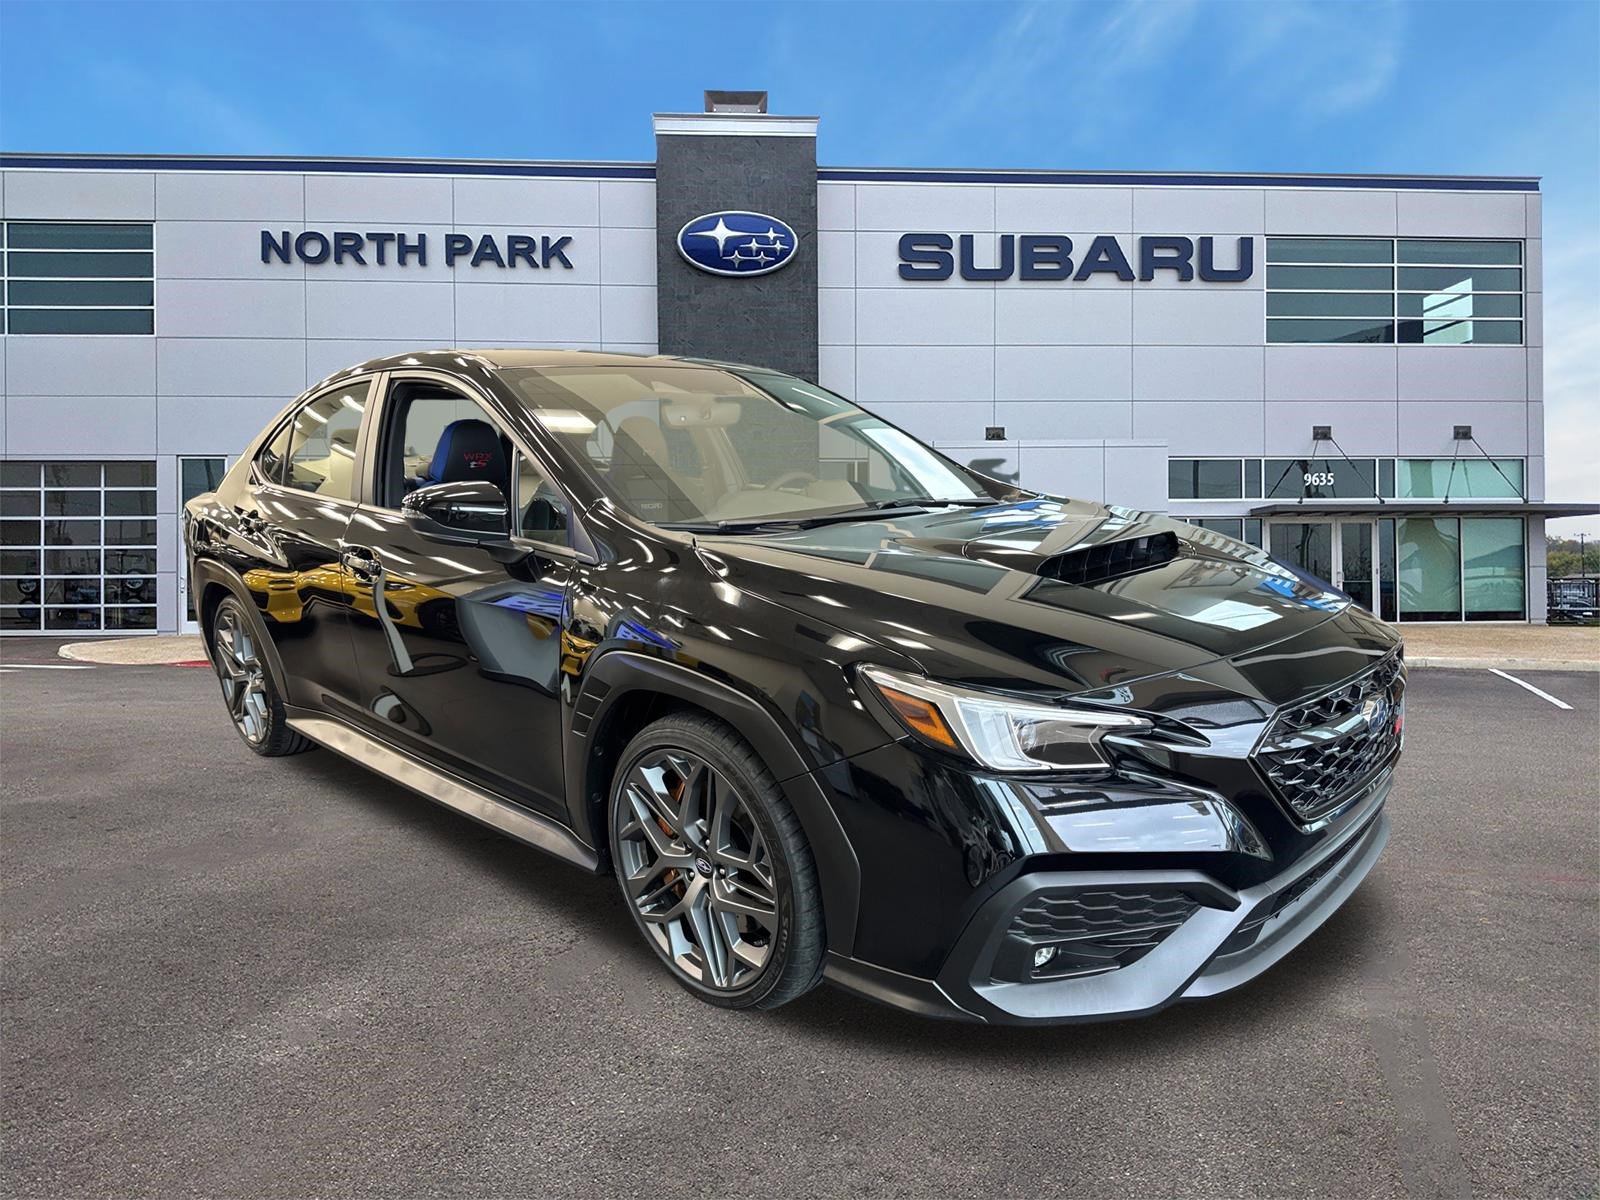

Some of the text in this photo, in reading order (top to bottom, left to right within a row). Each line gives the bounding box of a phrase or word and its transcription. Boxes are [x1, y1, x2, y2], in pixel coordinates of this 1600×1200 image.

[260, 230, 574, 269] NORTH PARK
[898, 232, 1254, 282] SUBARU
[1303, 472, 1335, 486] 9635
